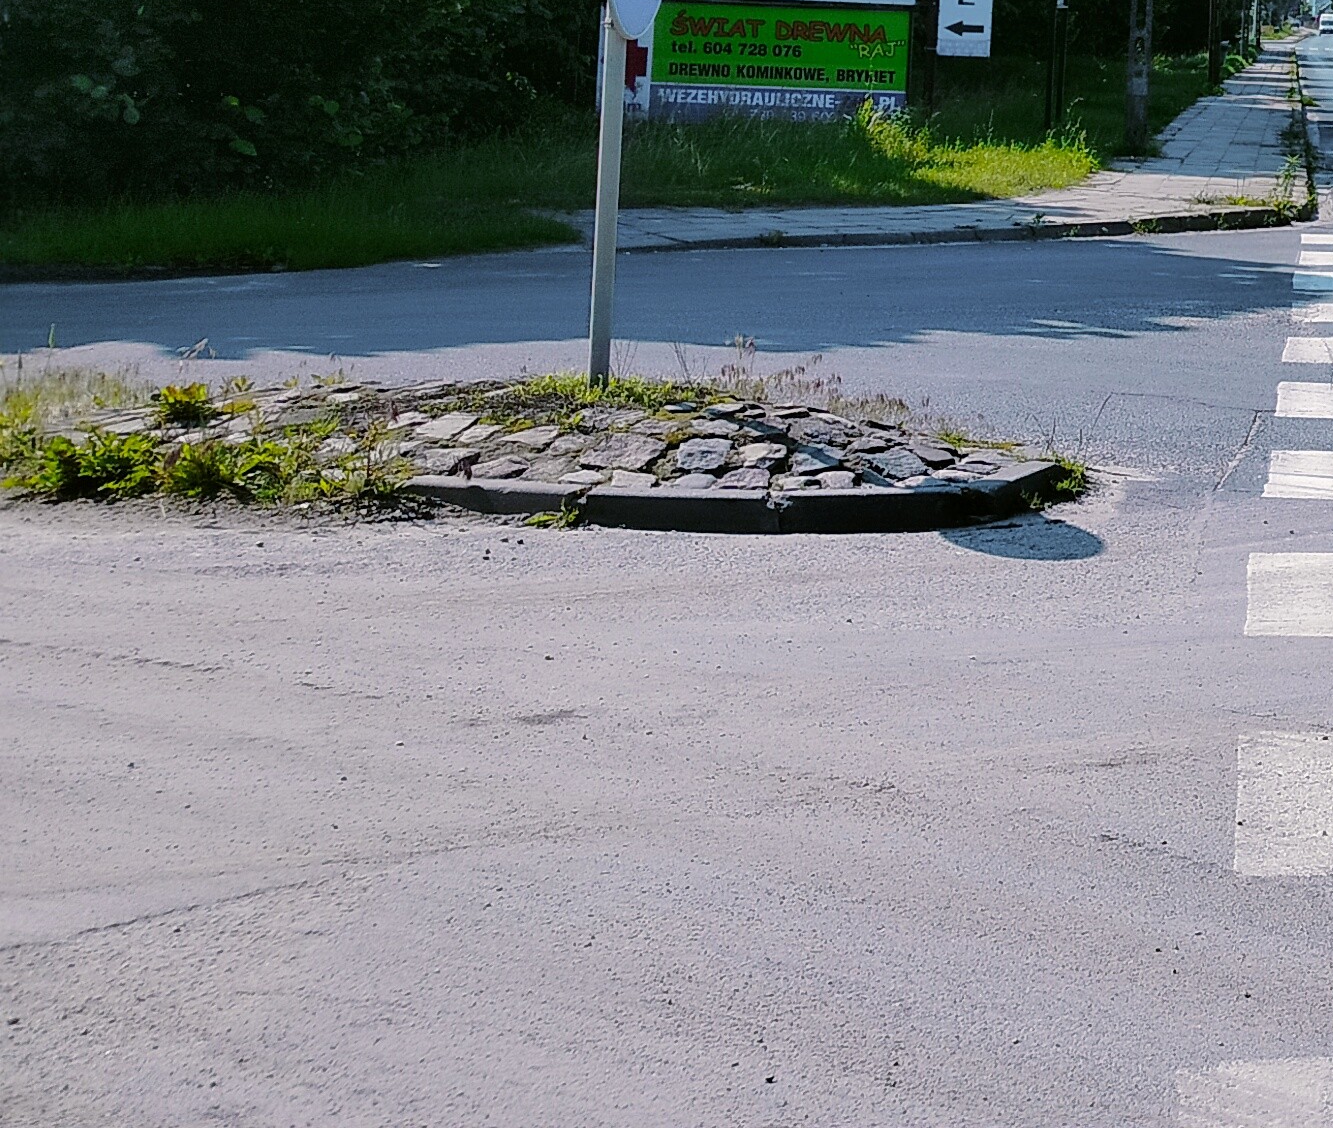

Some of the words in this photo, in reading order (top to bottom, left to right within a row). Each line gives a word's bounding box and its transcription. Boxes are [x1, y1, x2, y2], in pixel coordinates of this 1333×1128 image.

[669, 10, 766, 38] ŚWIAT
[775, 20, 887, 43] DREWNA
[671, 42, 697, 54] tel.
[703, 42, 732, 56] 604
[739, 43, 767, 57] 728
[773, 44, 802, 58] 076
[669, 62, 731, 78] DREWNO
[736, 64, 830, 83] KOMINKOWE,
[836, 69, 896, 84] BRYKIET
